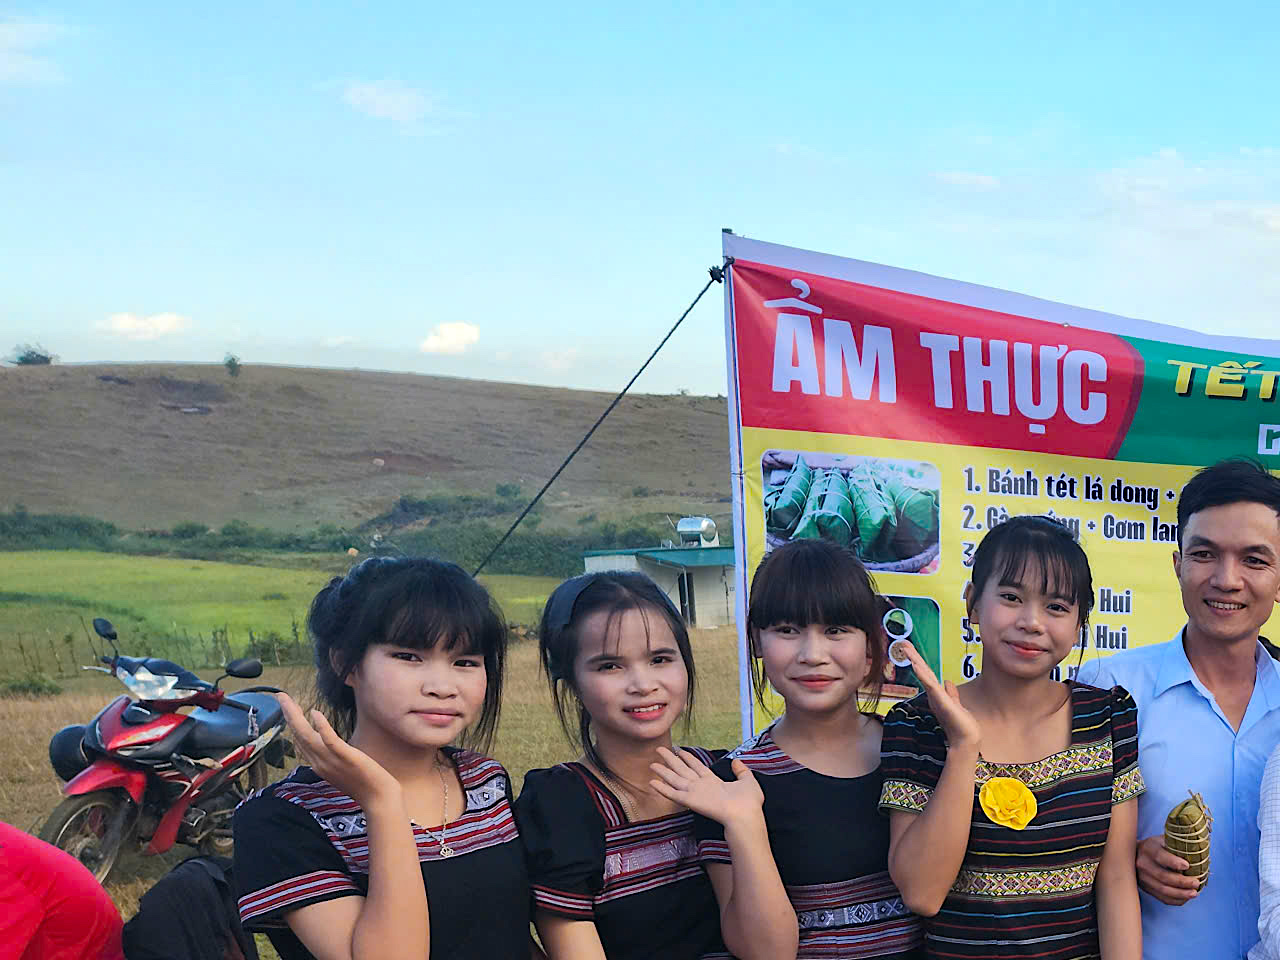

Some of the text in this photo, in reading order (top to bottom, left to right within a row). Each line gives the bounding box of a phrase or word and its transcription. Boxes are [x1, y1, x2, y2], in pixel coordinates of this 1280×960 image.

[764, 279, 1107, 434] ẨM THỰC
[964, 468, 981, 491] 1.
[988, 468, 1038, 496] Bánh
[1046, 473, 1077, 498] tét
[1085, 476, 1103, 501] lá
[1110, 480, 1159, 510] dong
[962, 505, 982, 530] 2.
[1103, 515, 1145, 540] Cơm
[1099, 589, 1131, 613] Hui
[962, 618, 981, 642] 5.
[1096, 625, 1127, 649] Hui
[963, 655, 981, 678] 6.
